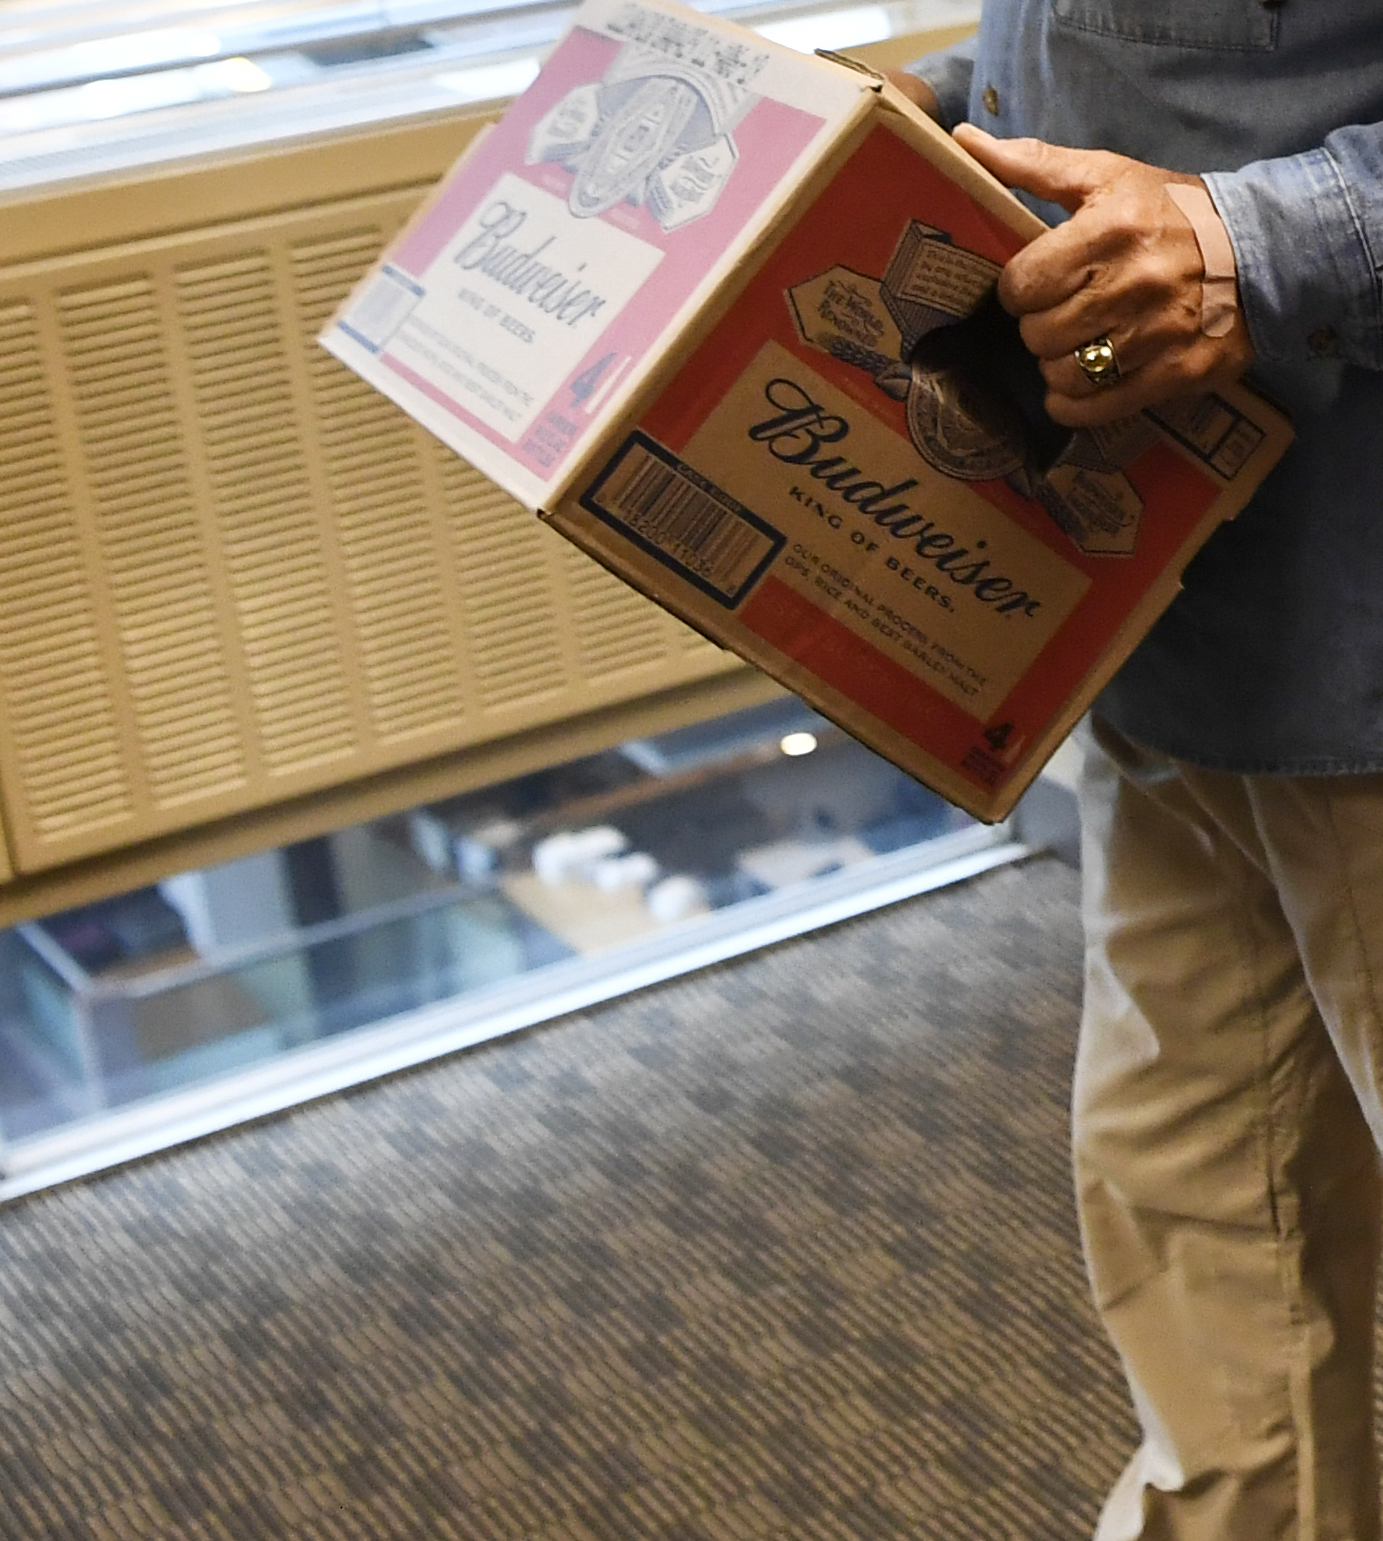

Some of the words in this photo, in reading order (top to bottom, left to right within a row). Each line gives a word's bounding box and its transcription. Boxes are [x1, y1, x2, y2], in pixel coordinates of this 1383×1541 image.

[452, 200, 607, 327] Budweiser
[748, 377, 1043, 619] Budweiser
[789, 486, 843, 530] KING
[850, 530, 880, 553] OF
[885, 555, 955, 614] BEERS.
